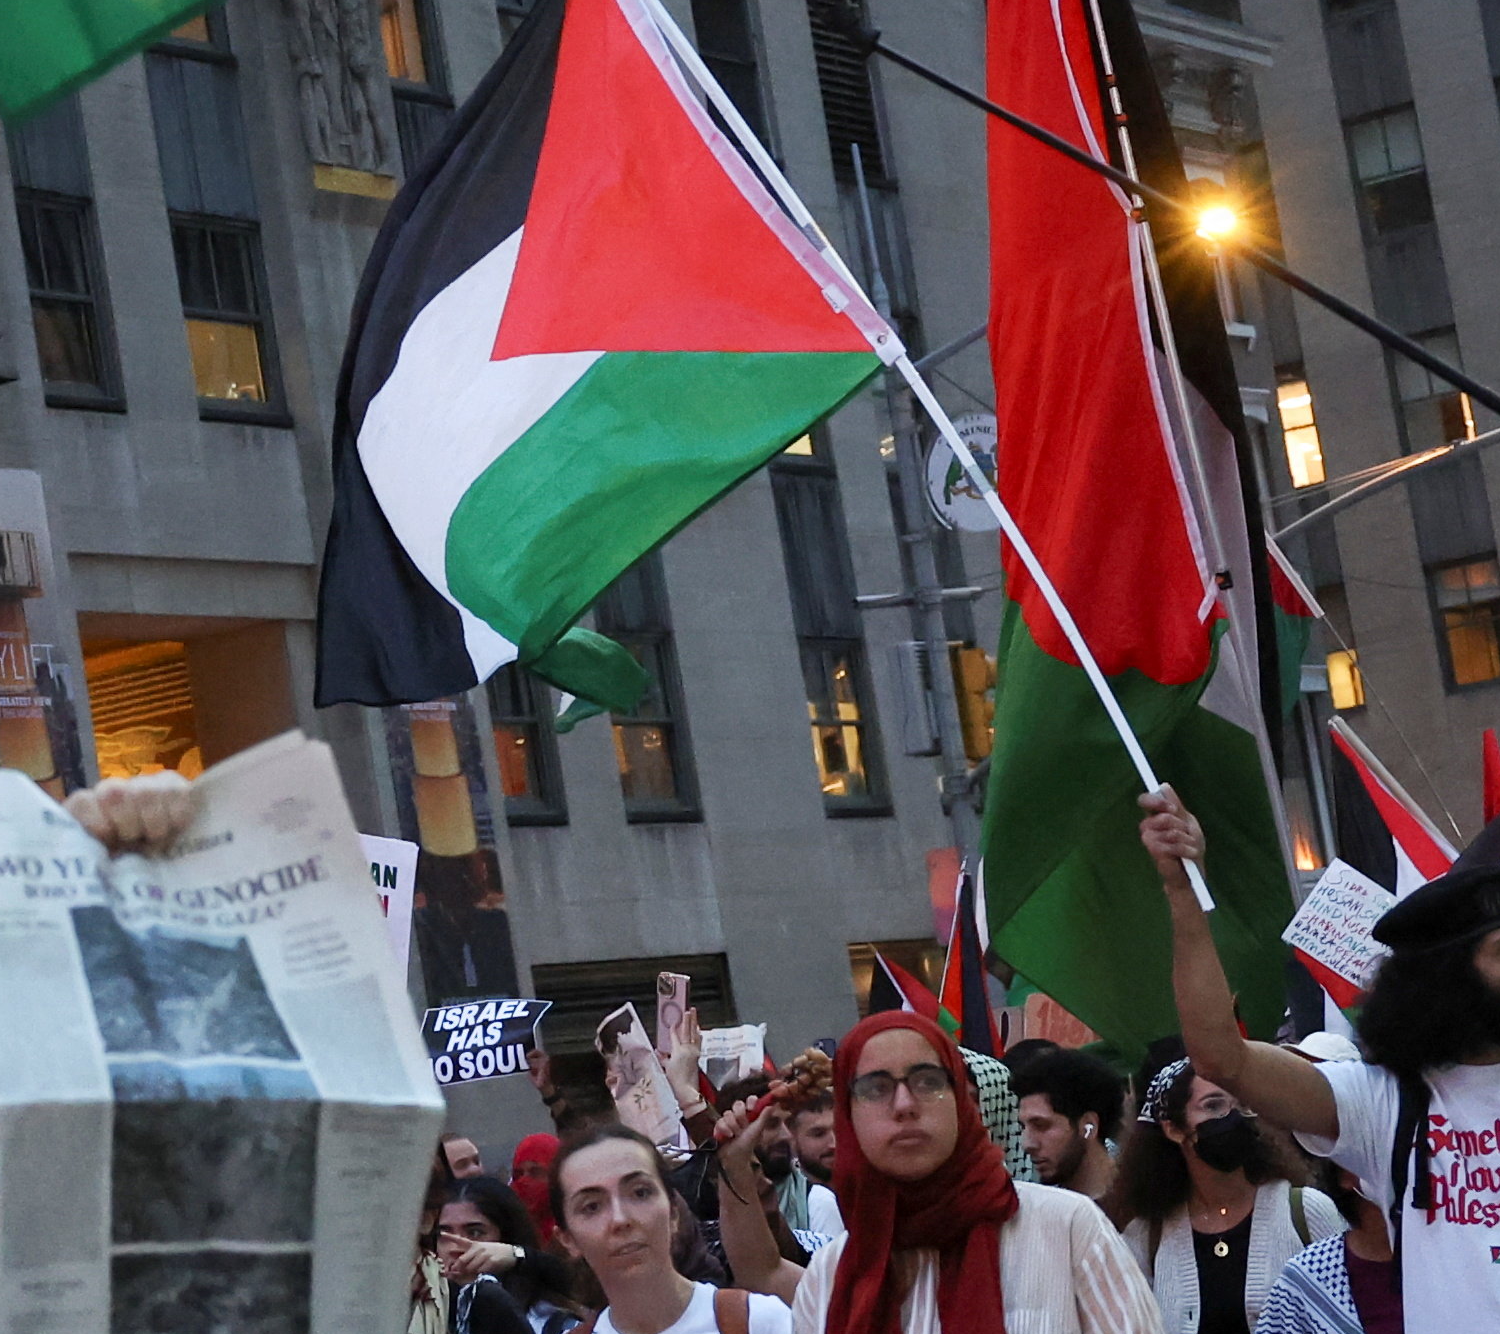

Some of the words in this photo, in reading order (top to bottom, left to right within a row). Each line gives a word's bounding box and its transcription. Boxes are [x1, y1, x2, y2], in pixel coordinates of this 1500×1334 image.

[174, 856, 330, 909] GENOCIDE
[1309, 897, 1341, 919] HIND
[434, 1000, 530, 1032] ISRAEL
[446, 1022, 503, 1053] HAS
[458, 1043, 531, 1080] SOUL
[1450, 1153, 1460, 1188] i
